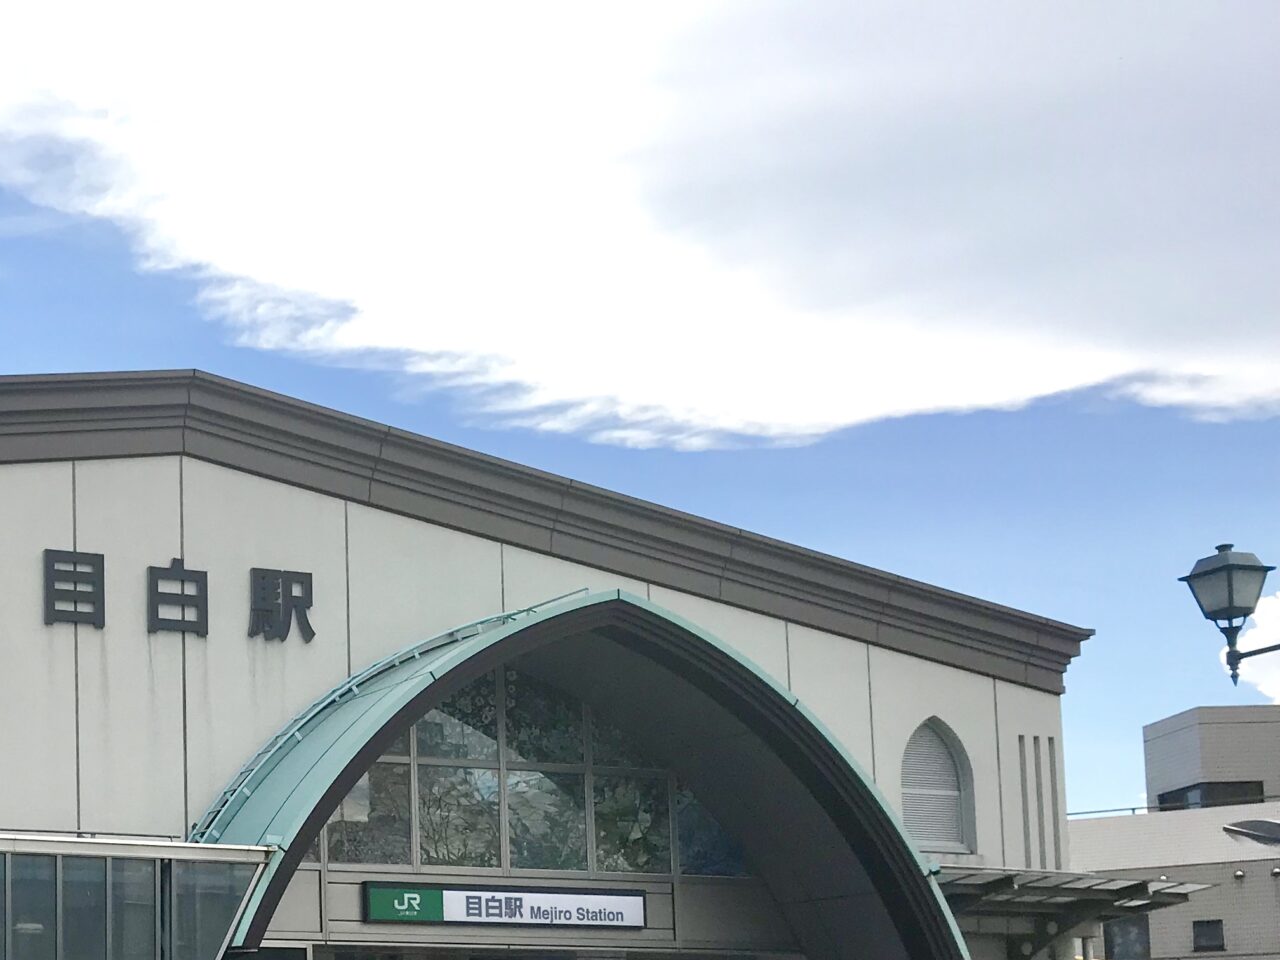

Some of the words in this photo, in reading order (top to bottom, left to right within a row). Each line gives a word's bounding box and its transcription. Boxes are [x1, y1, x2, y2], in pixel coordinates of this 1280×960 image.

[44, 549, 316, 644] 目白駅
[394, 893, 420, 910] JR
[465, 895, 523, 919] 目白駅
[530, 906, 572, 924] Mejiro
[576, 907, 624, 922] Station
